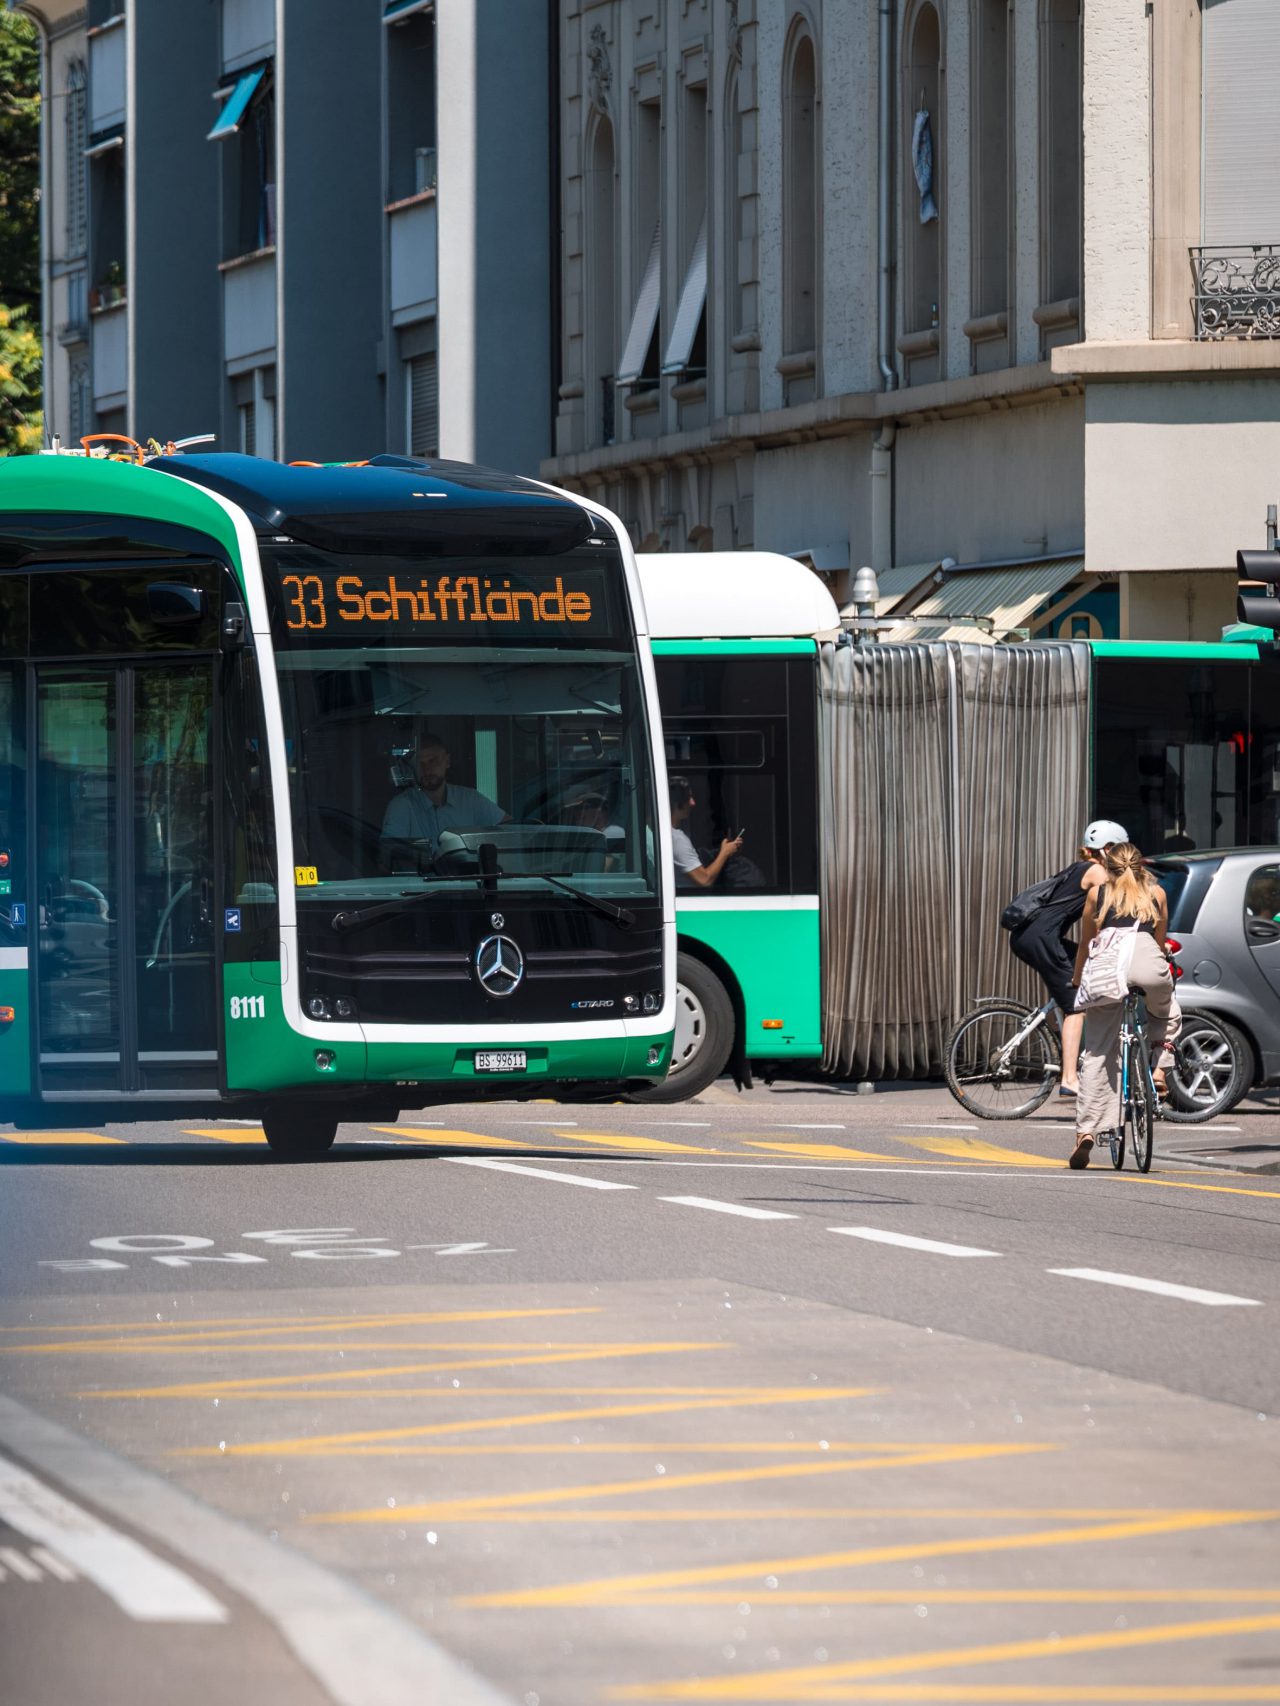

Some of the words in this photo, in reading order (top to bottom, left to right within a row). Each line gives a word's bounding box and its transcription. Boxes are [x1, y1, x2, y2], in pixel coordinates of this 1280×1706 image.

[282, 575, 327, 629] 33
[334, 575, 593, 625] Schifflände
[230, 995, 265, 1019] 8111
